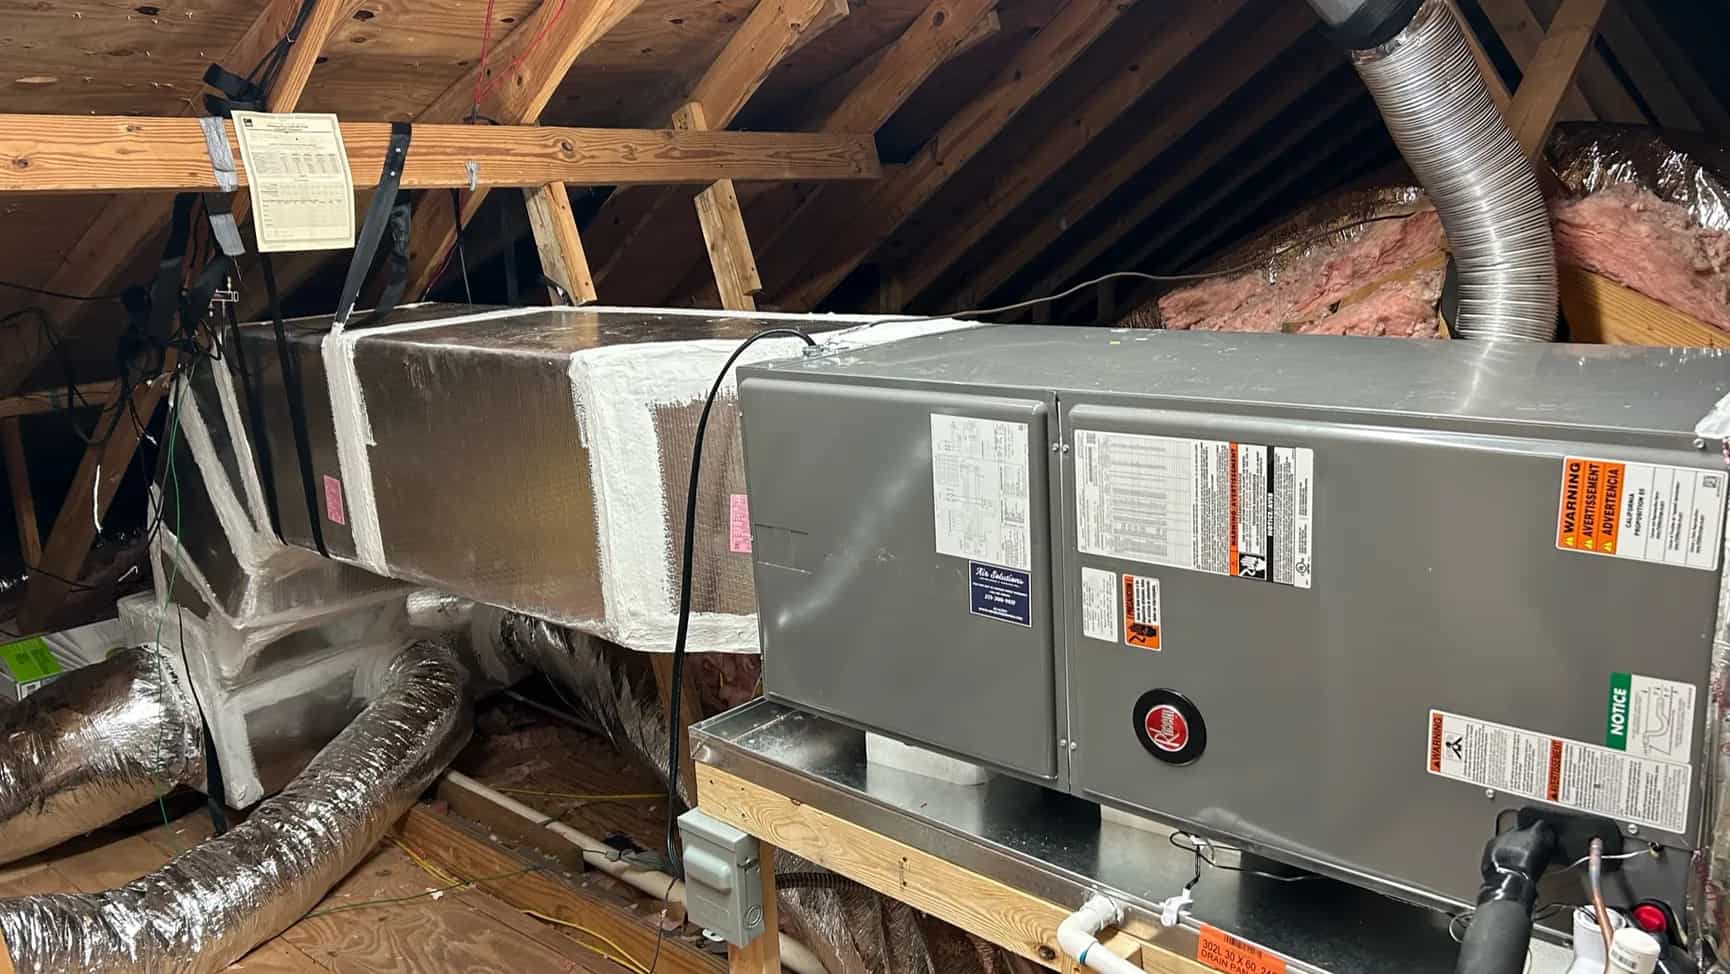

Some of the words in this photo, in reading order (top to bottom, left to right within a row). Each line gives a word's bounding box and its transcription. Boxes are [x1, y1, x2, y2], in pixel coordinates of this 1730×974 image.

[1563, 463, 1581, 534] WARNING
[1581, 463, 1600, 538] AVERTISSEMENT
[1601, 468, 1619, 536] ADVERTENCIA
[1610, 688, 1627, 736] NOTICE
[1431, 716, 1443, 758] WARNING
[1200, 949, 1229, 968] DRAIN
[1202, 939, 1222, 956] 302L
[1224, 949, 1236, 962] 30
[1245, 960, 1257, 972] 60
